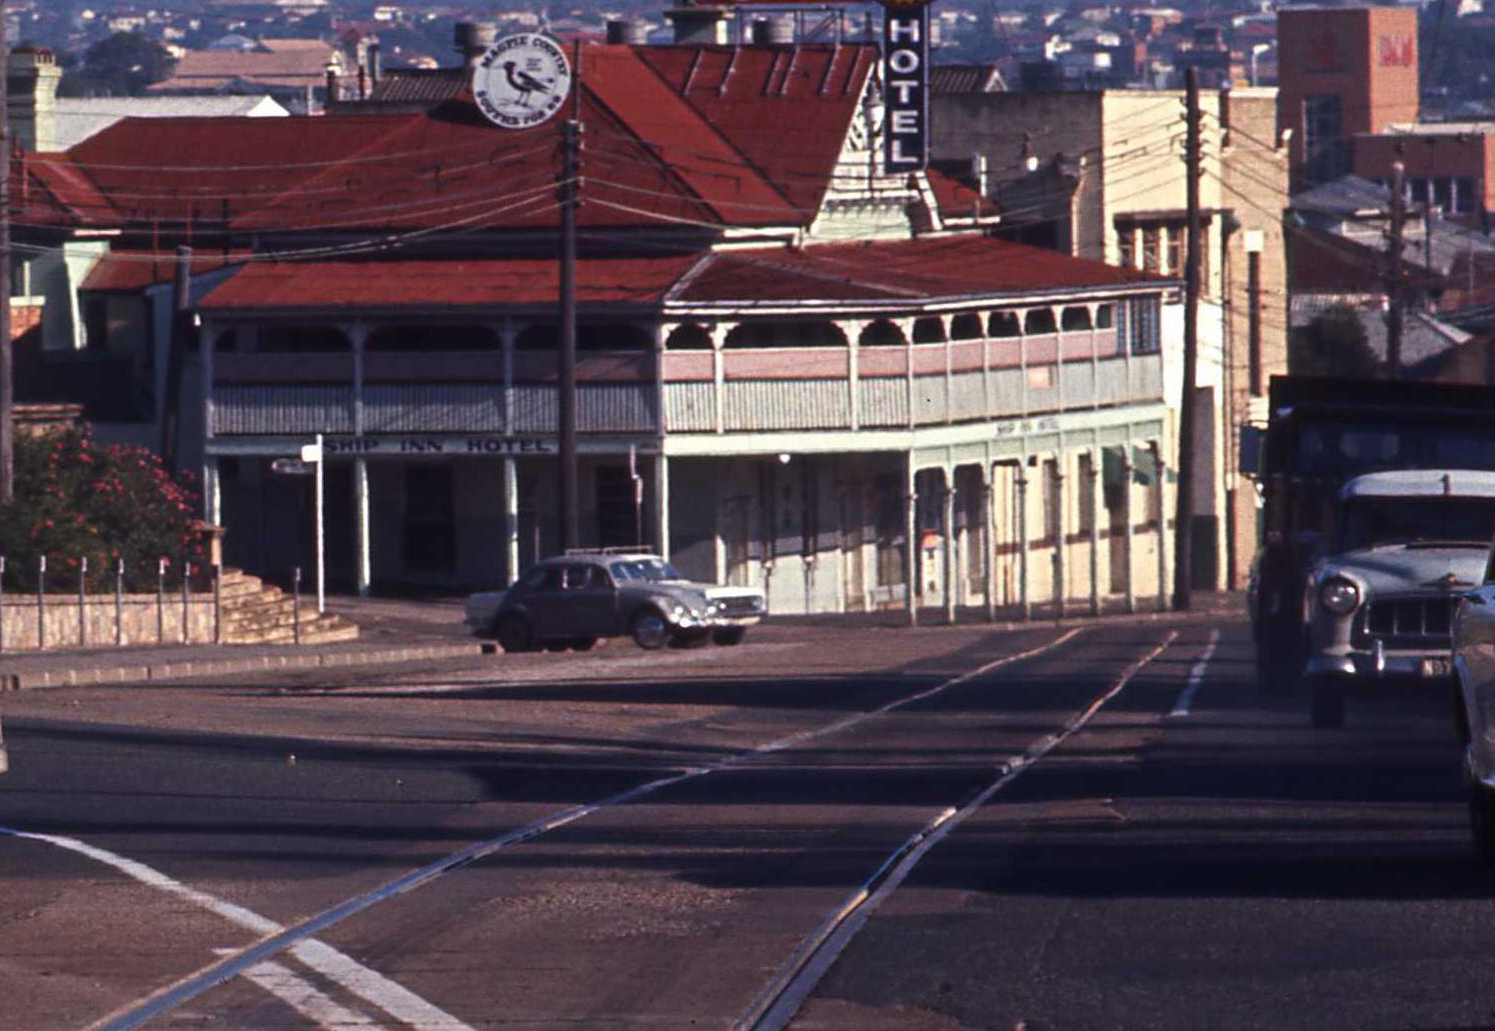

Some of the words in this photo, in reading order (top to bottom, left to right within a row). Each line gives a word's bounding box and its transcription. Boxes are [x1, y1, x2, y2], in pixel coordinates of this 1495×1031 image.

[889, 18, 920, 164] HOTEL
[323, 436, 380, 454] SHIP
[399, 438, 444, 453] INN
[466, 437, 552, 453] HOTEL
